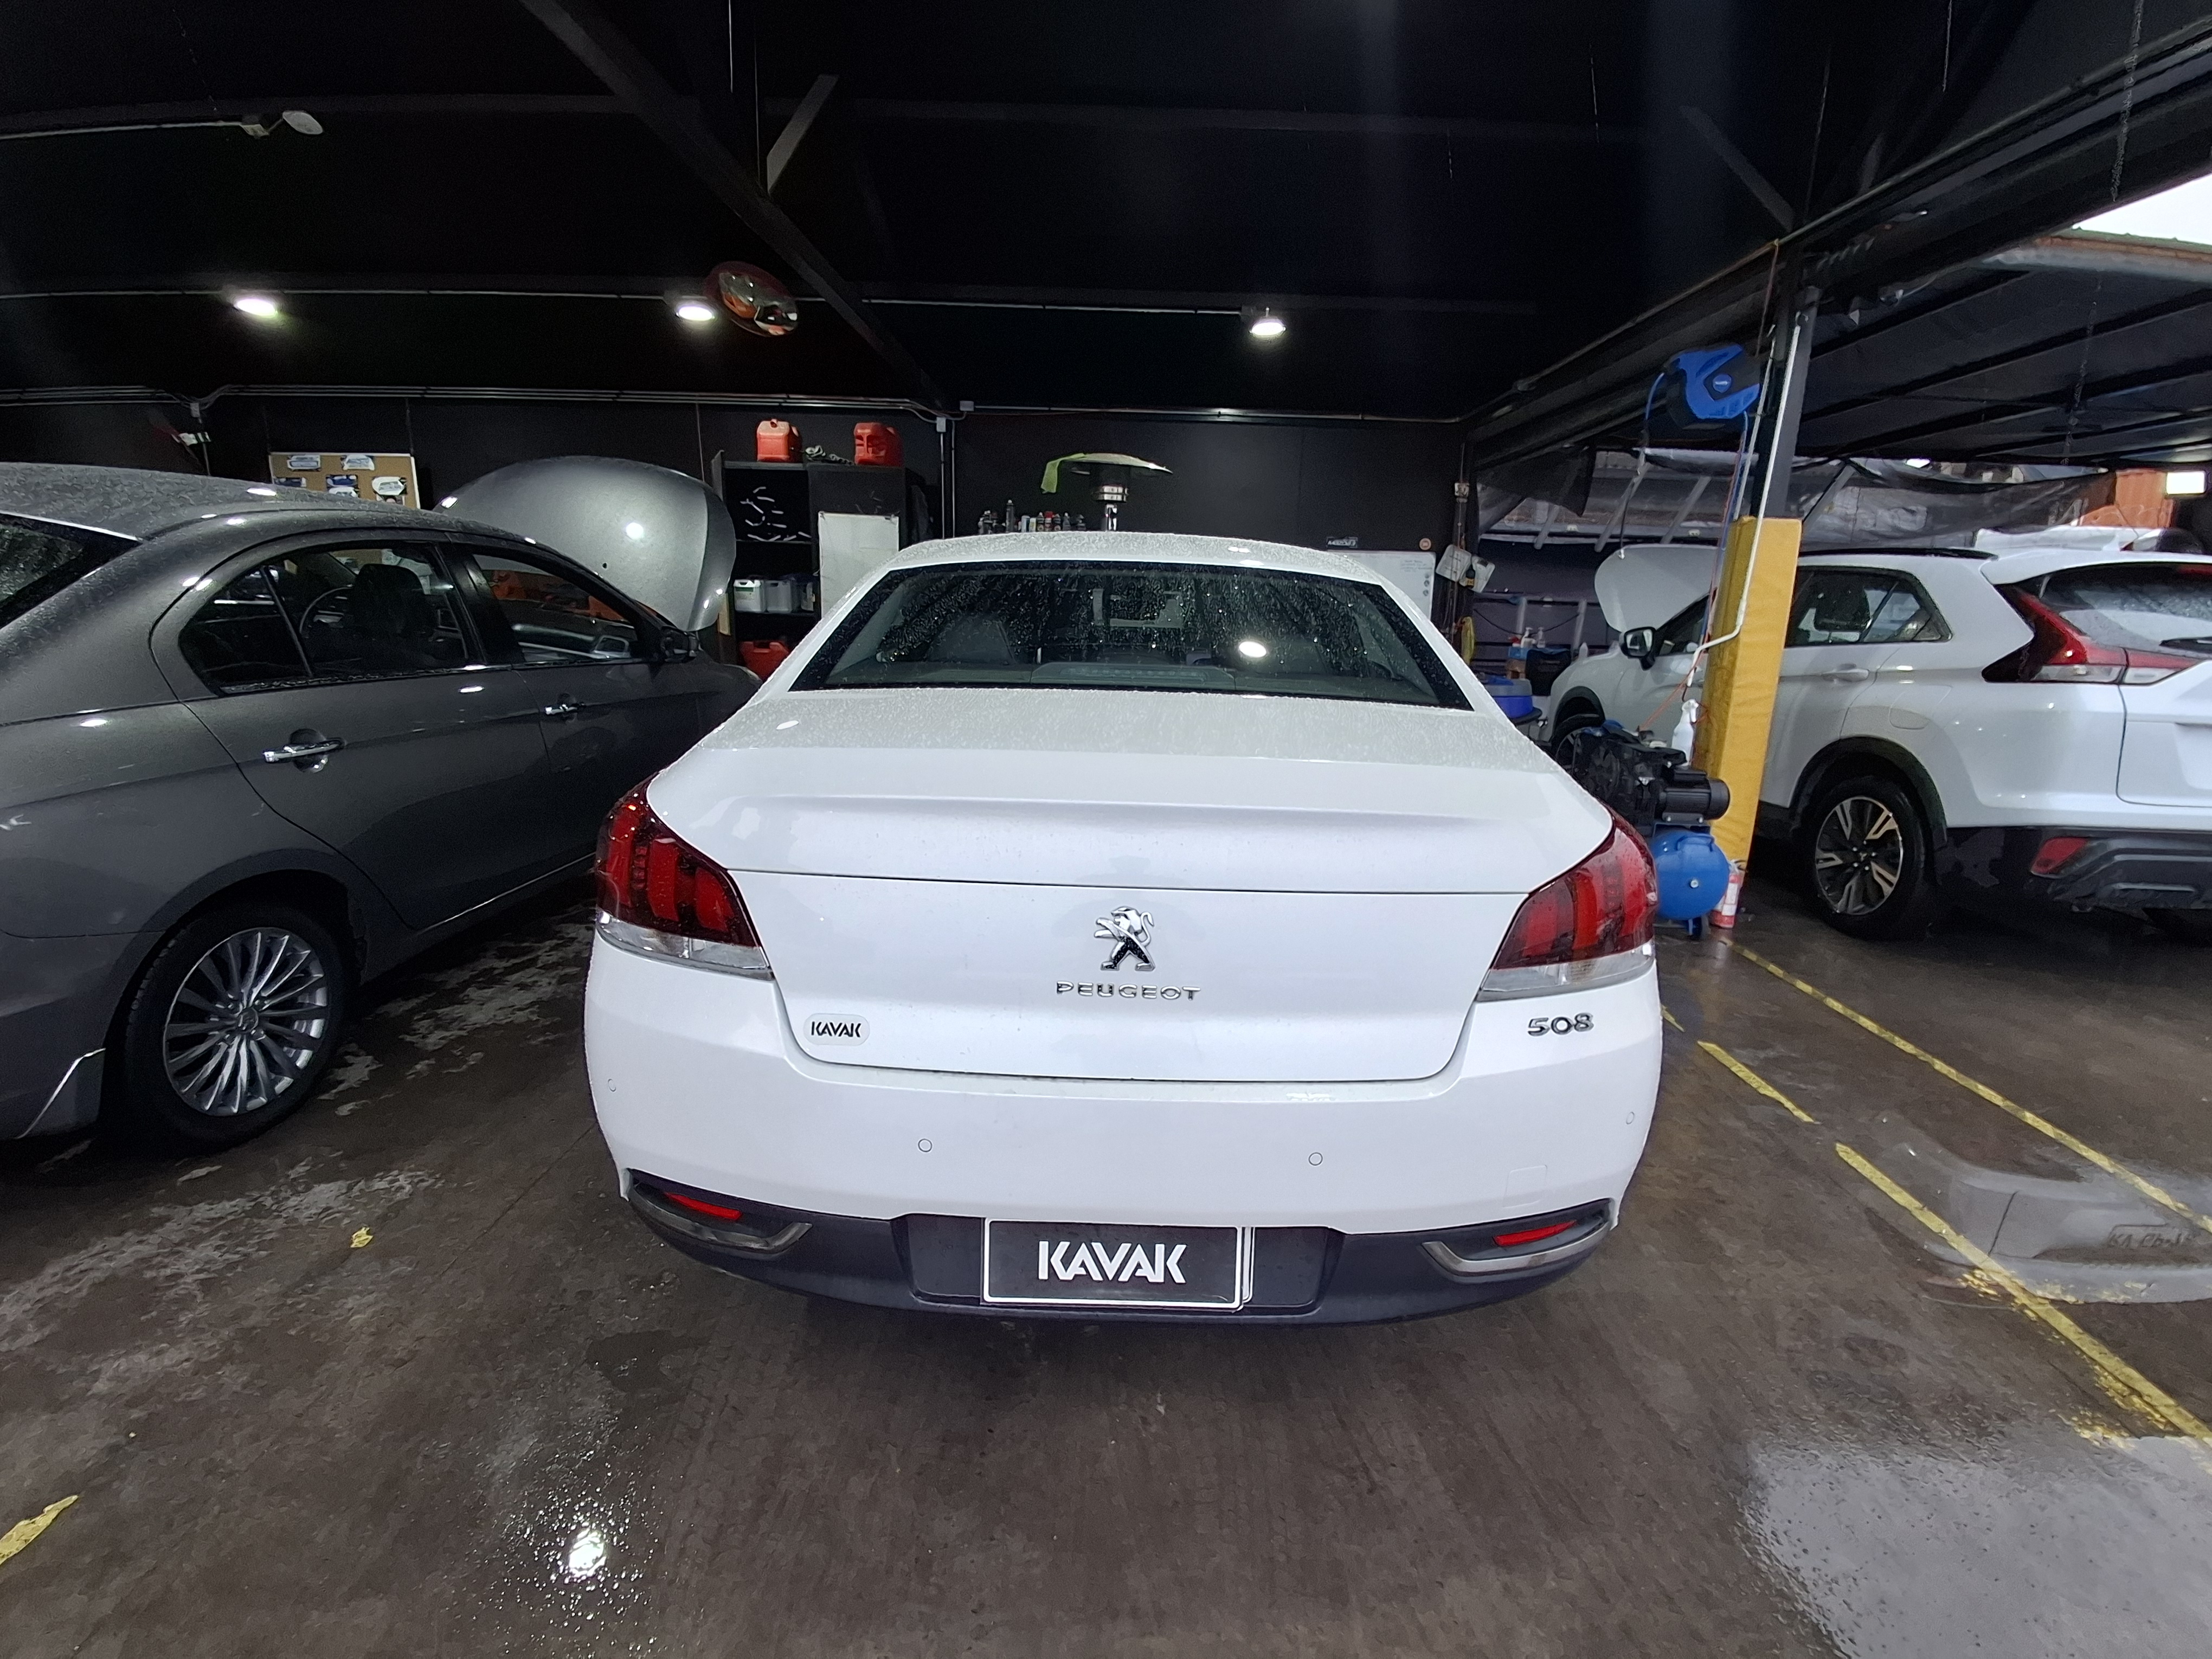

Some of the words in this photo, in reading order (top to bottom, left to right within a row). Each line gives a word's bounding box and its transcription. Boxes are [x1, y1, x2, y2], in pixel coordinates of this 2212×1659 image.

[1057, 981, 1201, 1000] PEUGEOT
[811, 1021, 861, 1038] KAVAK
[1527, 1012, 1594, 1037] 508
[1038, 1240, 1187, 1283] KAVAK
